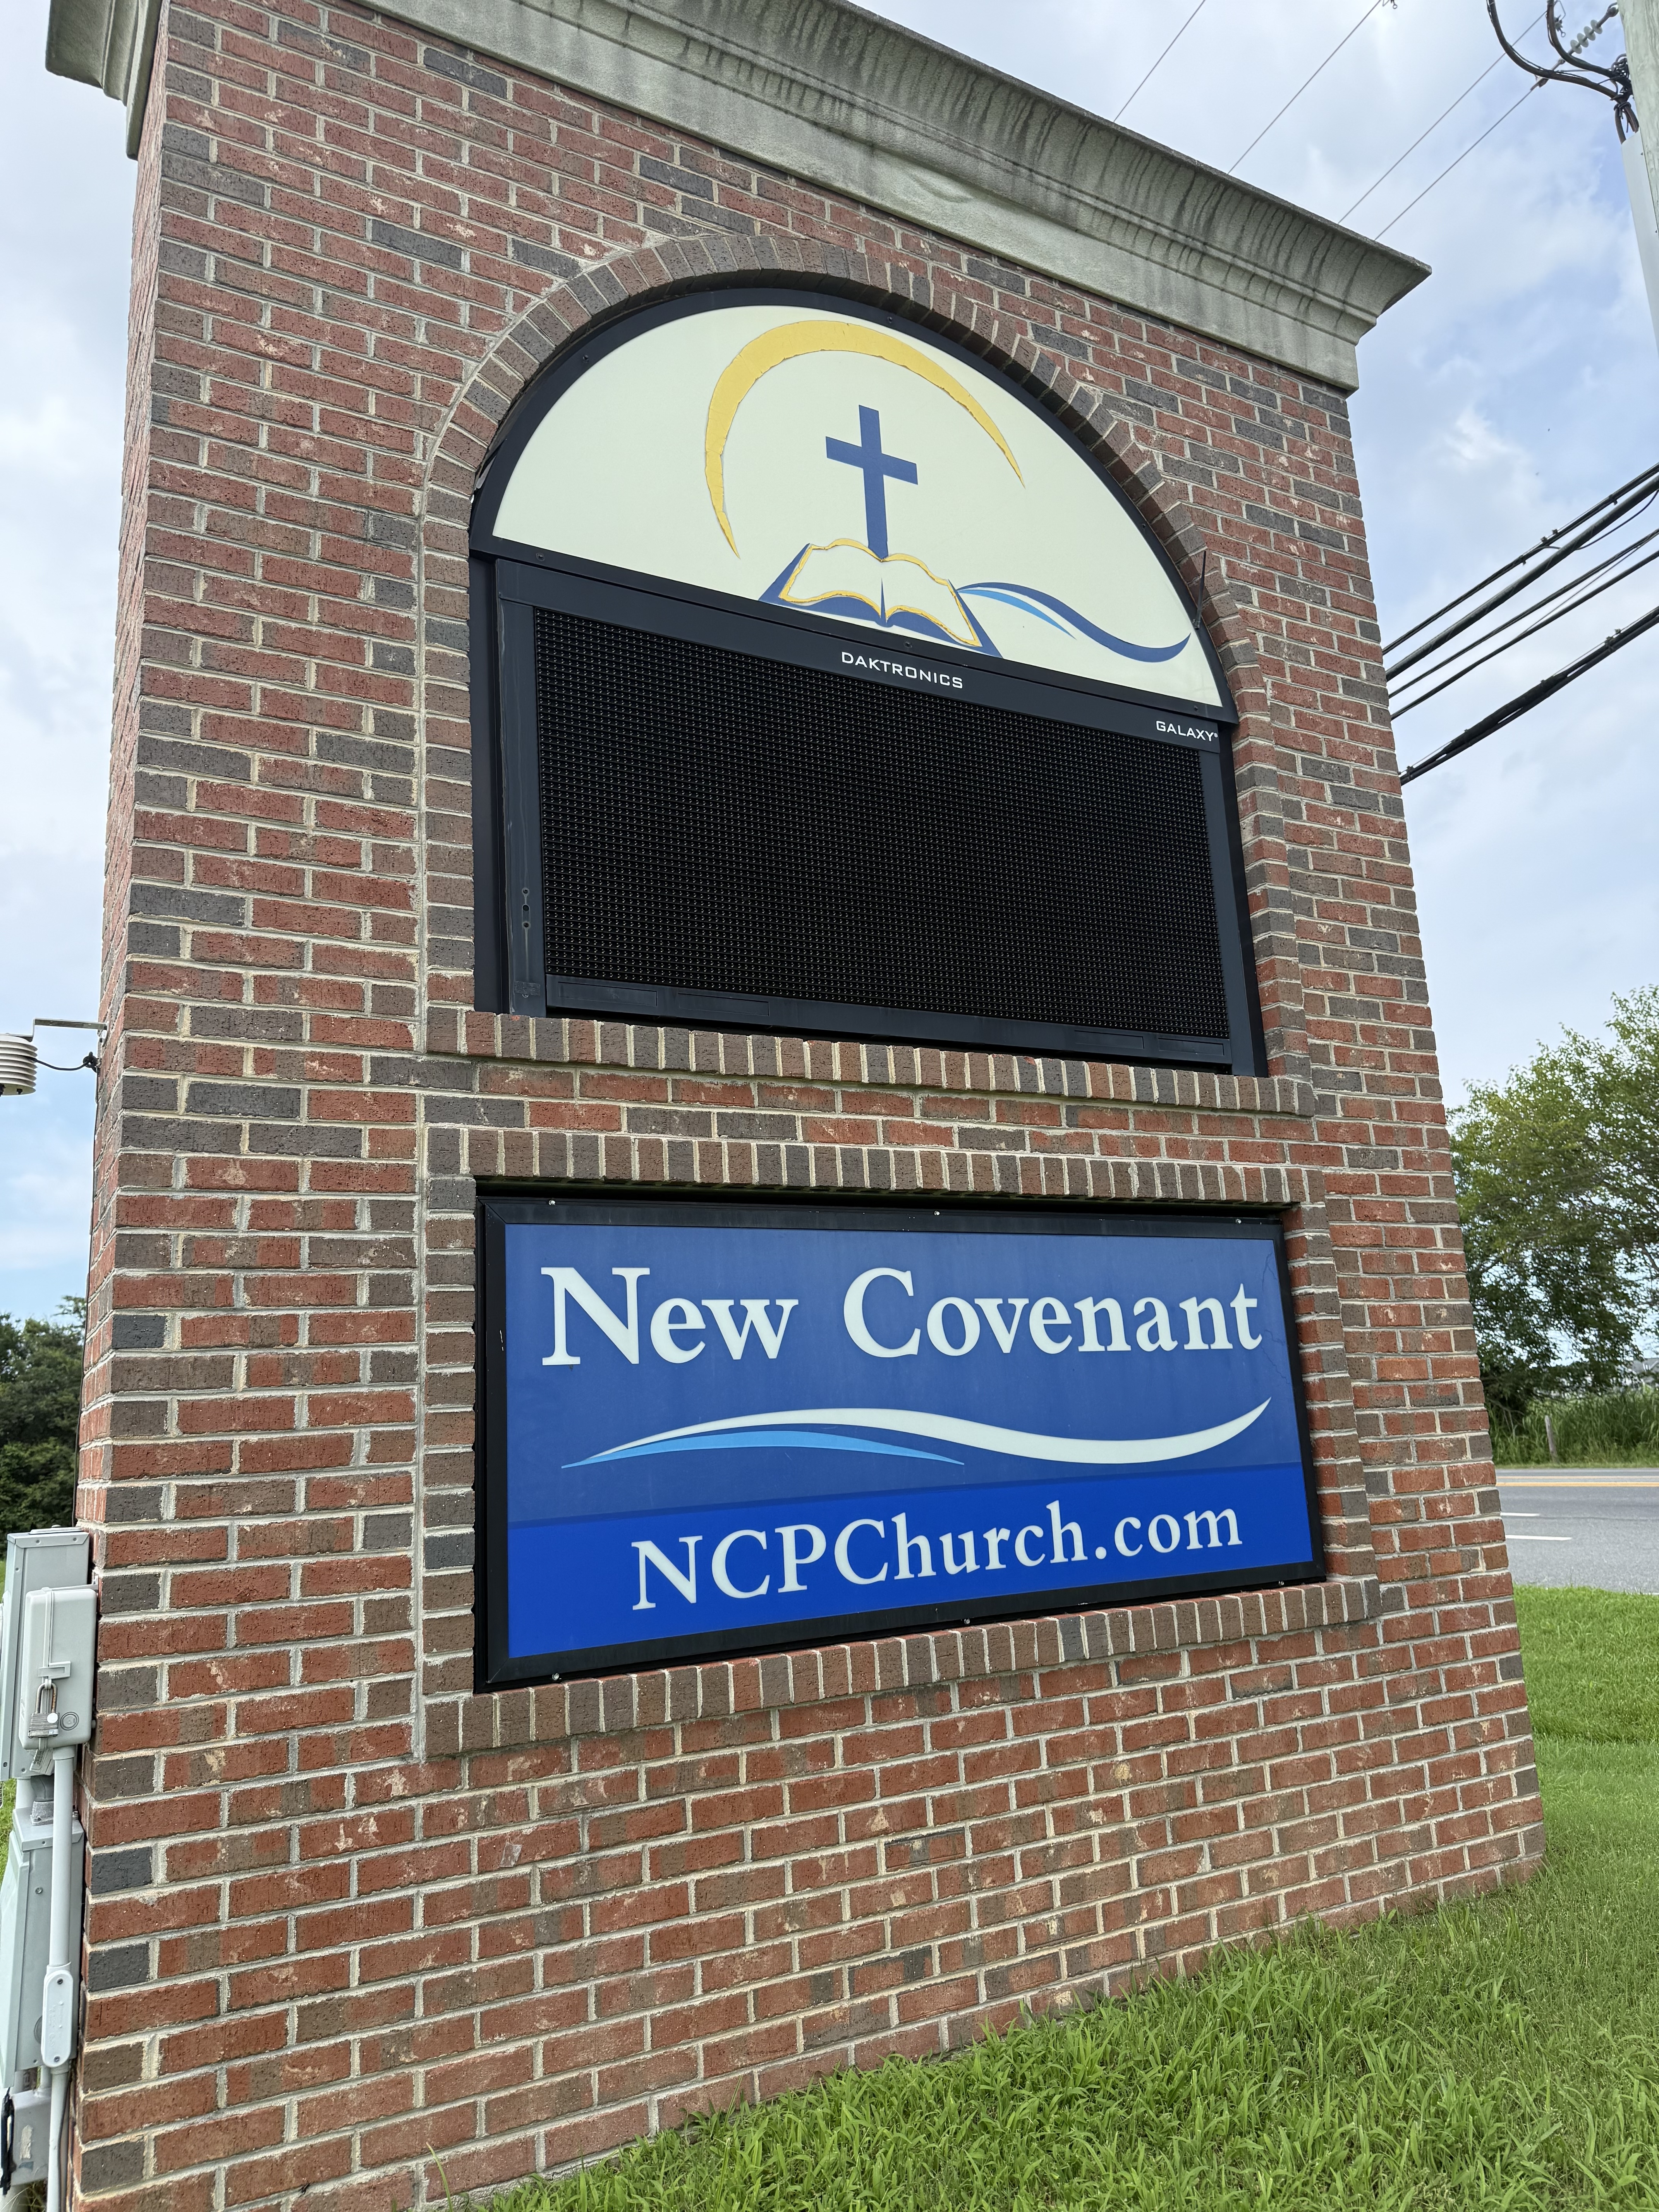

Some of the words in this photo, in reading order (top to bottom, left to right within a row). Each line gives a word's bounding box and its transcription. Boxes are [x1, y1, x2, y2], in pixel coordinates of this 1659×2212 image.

[841, 651, 963, 689] DAKTRONICS
[541, 1267, 799, 1366] New
[843, 1267, 1262, 1358] Covenant
[631, 1500, 1243, 1610] NCPChurch.com
